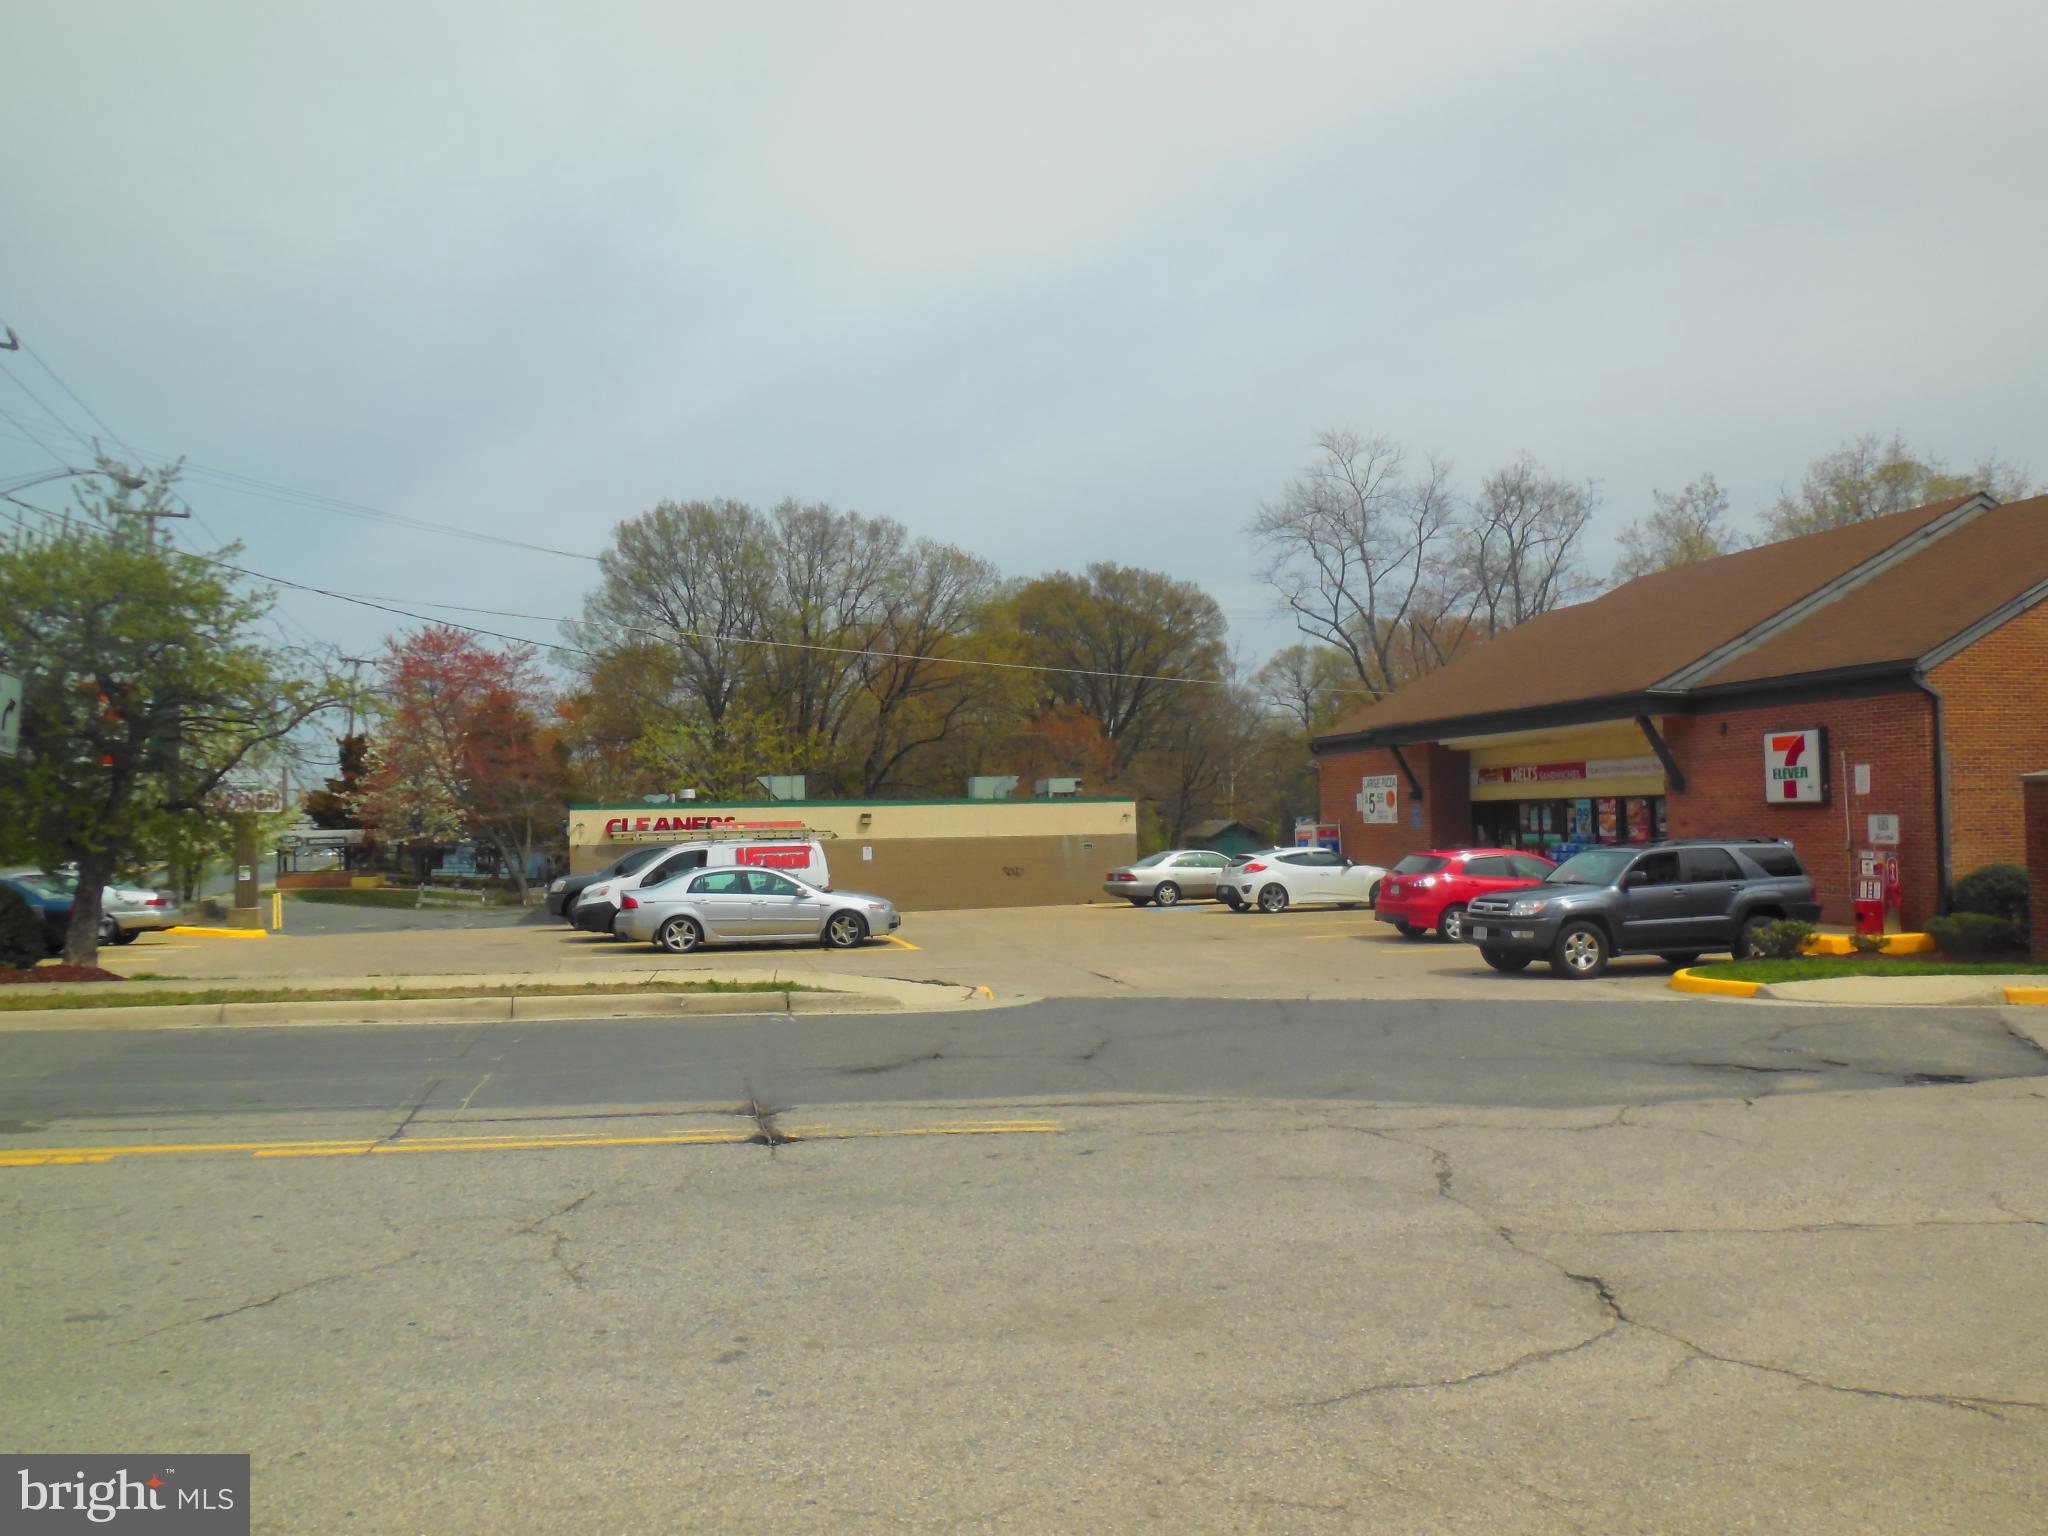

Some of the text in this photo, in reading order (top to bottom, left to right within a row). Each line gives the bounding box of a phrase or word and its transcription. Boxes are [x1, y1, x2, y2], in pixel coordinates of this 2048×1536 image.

[1510, 766, 1538, 783] MELTS
[1772, 734, 1805, 798] 7
[1382, 776, 1396, 788] PIZZA
